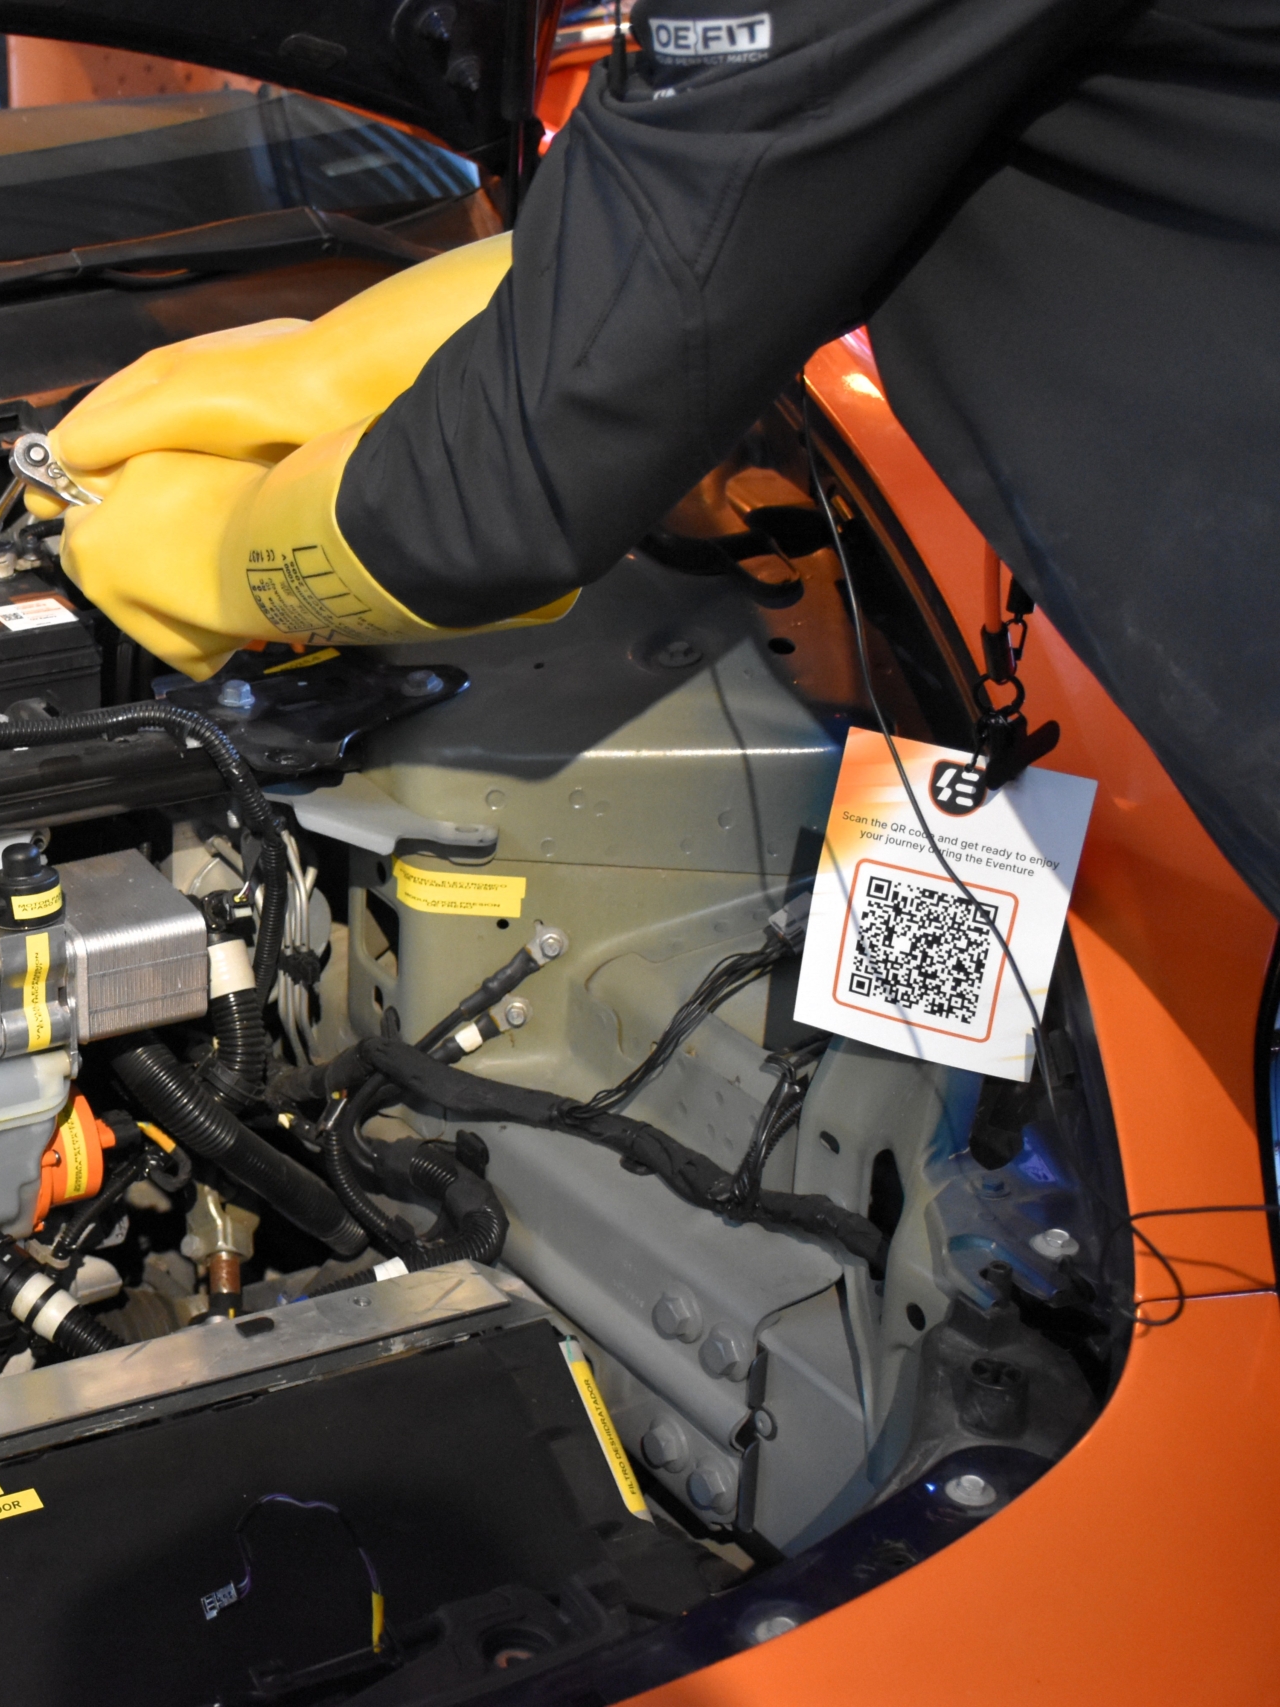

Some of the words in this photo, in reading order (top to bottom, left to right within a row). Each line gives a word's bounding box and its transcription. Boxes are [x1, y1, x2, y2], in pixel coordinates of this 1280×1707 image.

[726, 52, 768, 64] MATCH
[842, 811, 869, 825] Scan
[870, 817, 888, 830] the
[890, 821, 907, 834] QR
[937, 833, 959, 847] and
[960, 840, 979, 855] get
[981, 843, 1012, 861] ready
[1015, 851, 1027, 863] to
[1029, 855, 1061, 872] enjoy
[859, 829, 884, 842] your
[884, 834, 926, 854] journey
[927, 844, 963, 863] dring
[965, 852, 983, 866] the
[985, 857, 1036, 878] Eventure
[18, 899, 50, 909] MOTOR
[583, 1378, 622, 1460] DESHIDRATADOR
[619, 1461, 637, 1495] FILTRO
